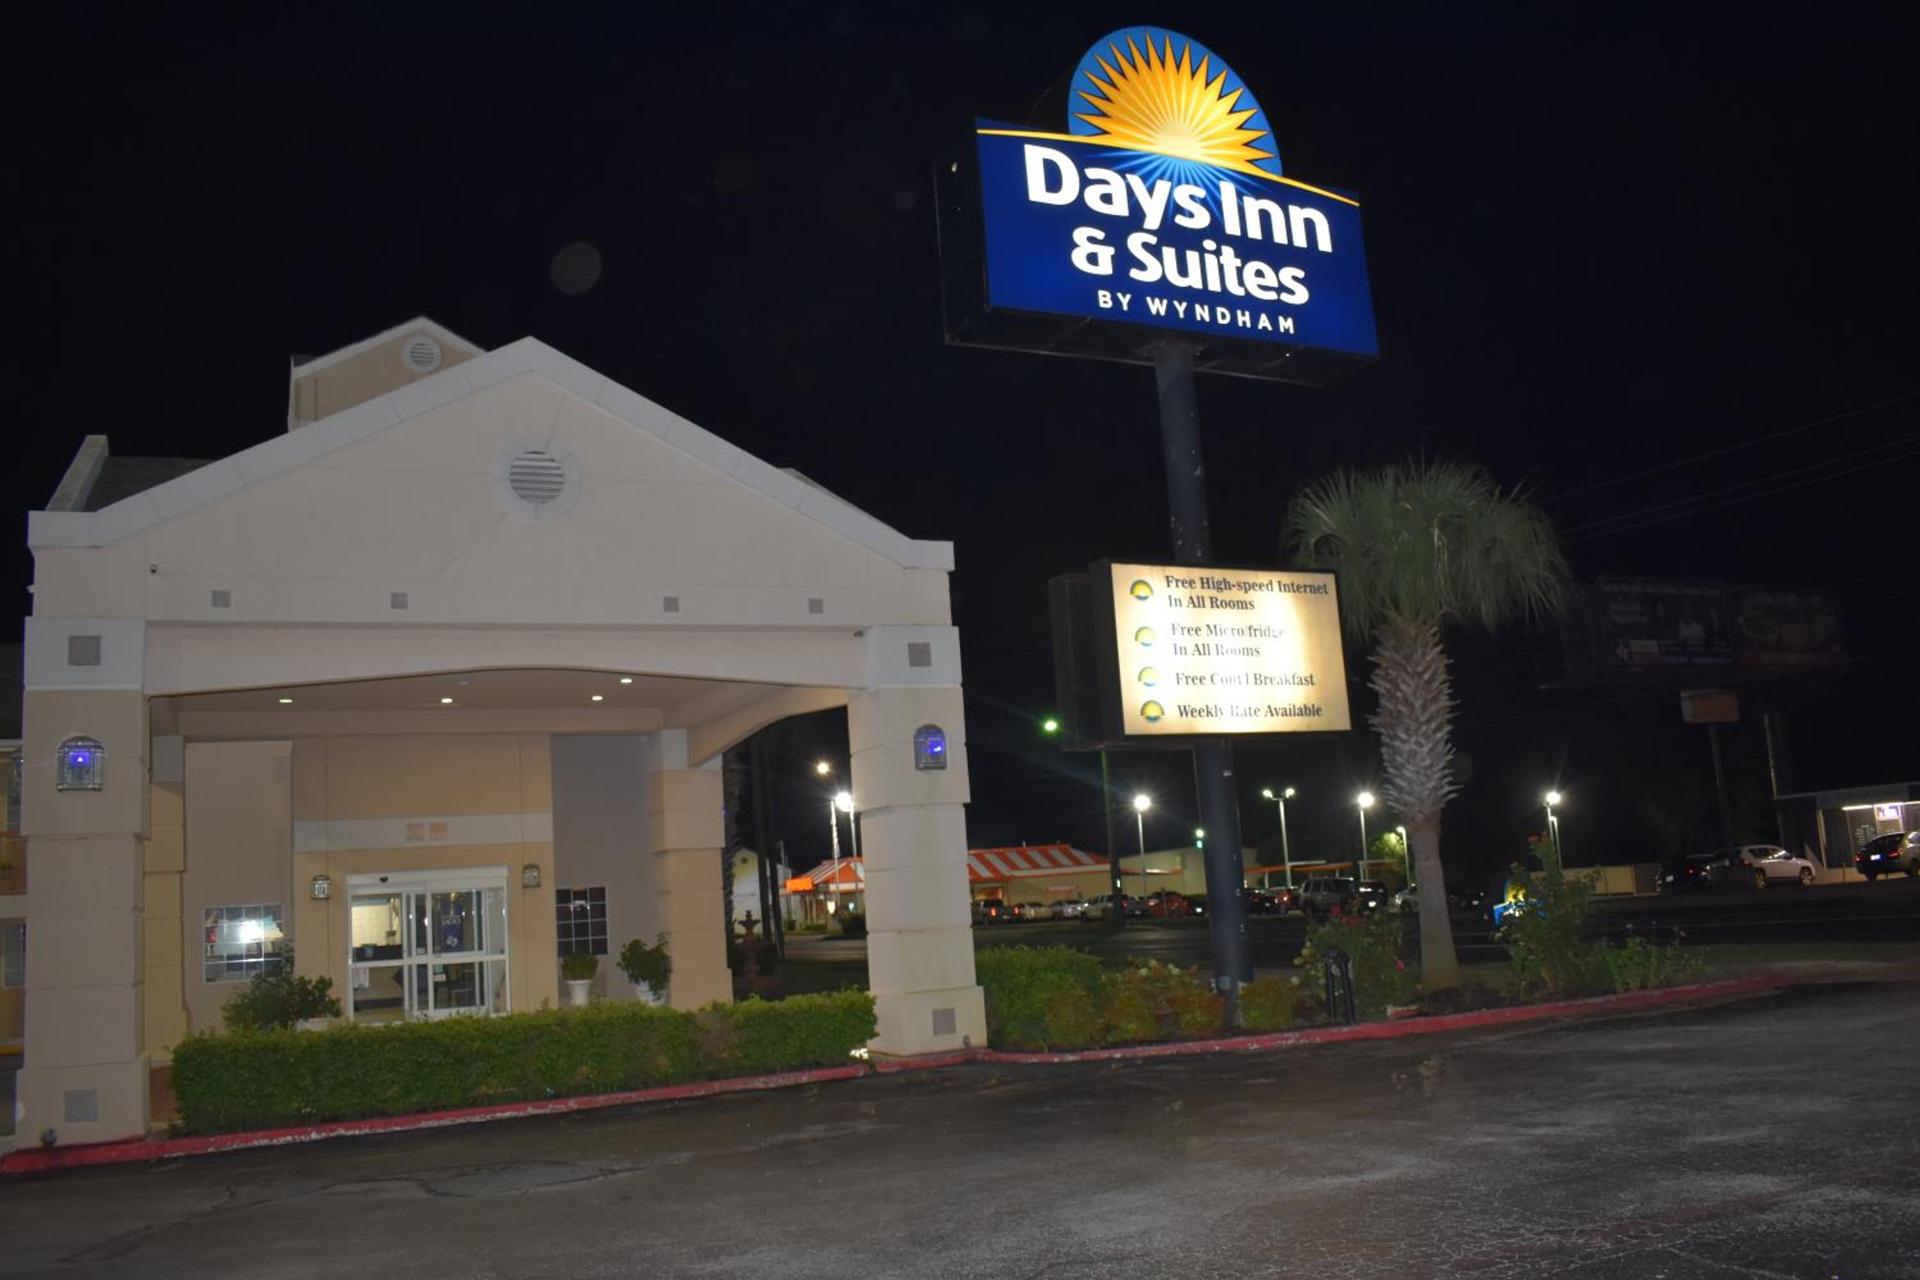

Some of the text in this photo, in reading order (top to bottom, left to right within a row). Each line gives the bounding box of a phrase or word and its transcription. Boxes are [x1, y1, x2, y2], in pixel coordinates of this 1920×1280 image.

[1024, 143, 1333, 253] Days Inn
[1070, 226, 1310, 306] & Suites
[1097, 289, 1296, 334] BY WYNDHAM
[1165, 575, 1329, 595] Free High-speed Internet
[1168, 594, 1255, 610] In All Rooms
[1171, 622, 1202, 637] Free
[1173, 643, 1261, 658] In All Rooms
[1175, 672, 1206, 686] Free
[1253, 672, 1316, 687] Breakfast
[1177, 704, 1224, 720] Weekly
[1264, 704, 1323, 718] Available
